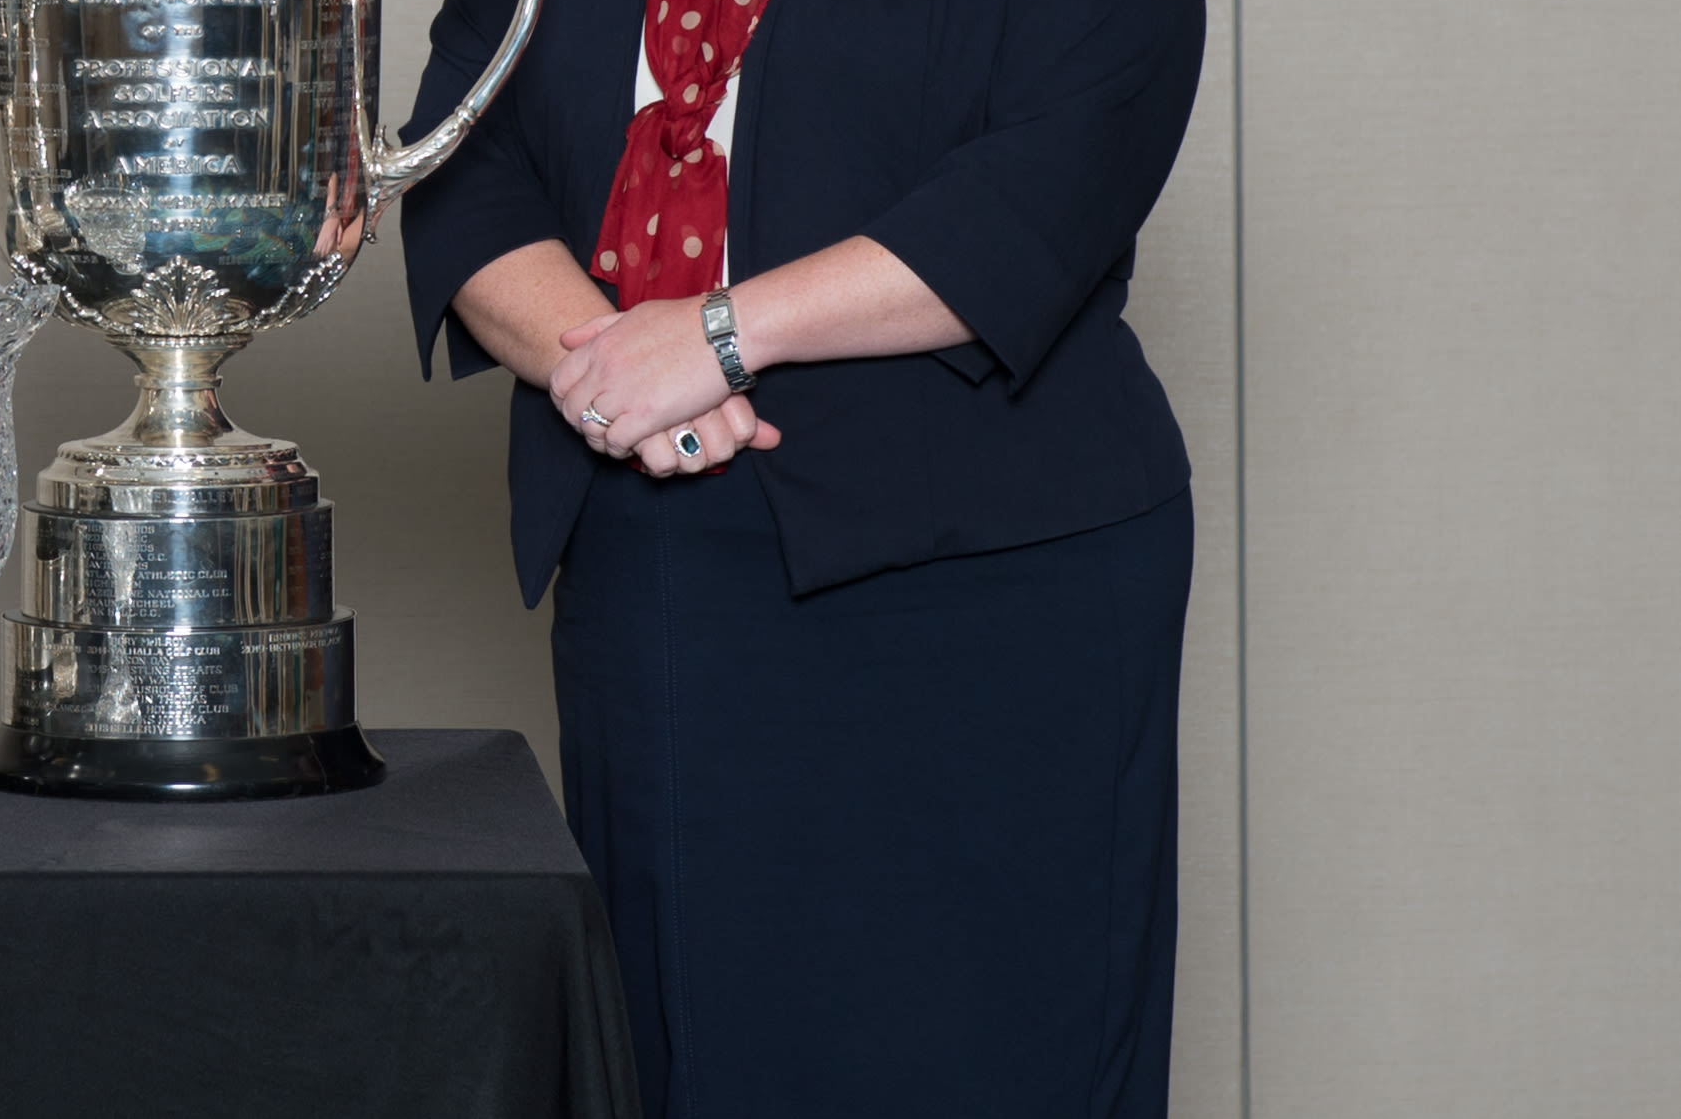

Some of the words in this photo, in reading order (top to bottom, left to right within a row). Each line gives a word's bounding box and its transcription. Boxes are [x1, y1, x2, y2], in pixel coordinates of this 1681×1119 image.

[141, 25, 166, 37] OF
[74, 58, 276, 79] PROFESSIONAL
[114, 83, 235, 103] GOLFERS
[83, 107, 270, 129] ASSOCIATION
[114, 154, 241, 175] AMERICA
[137, 570, 195, 580] ATHLETIC
[147, 588, 209, 599] NATIONAL
